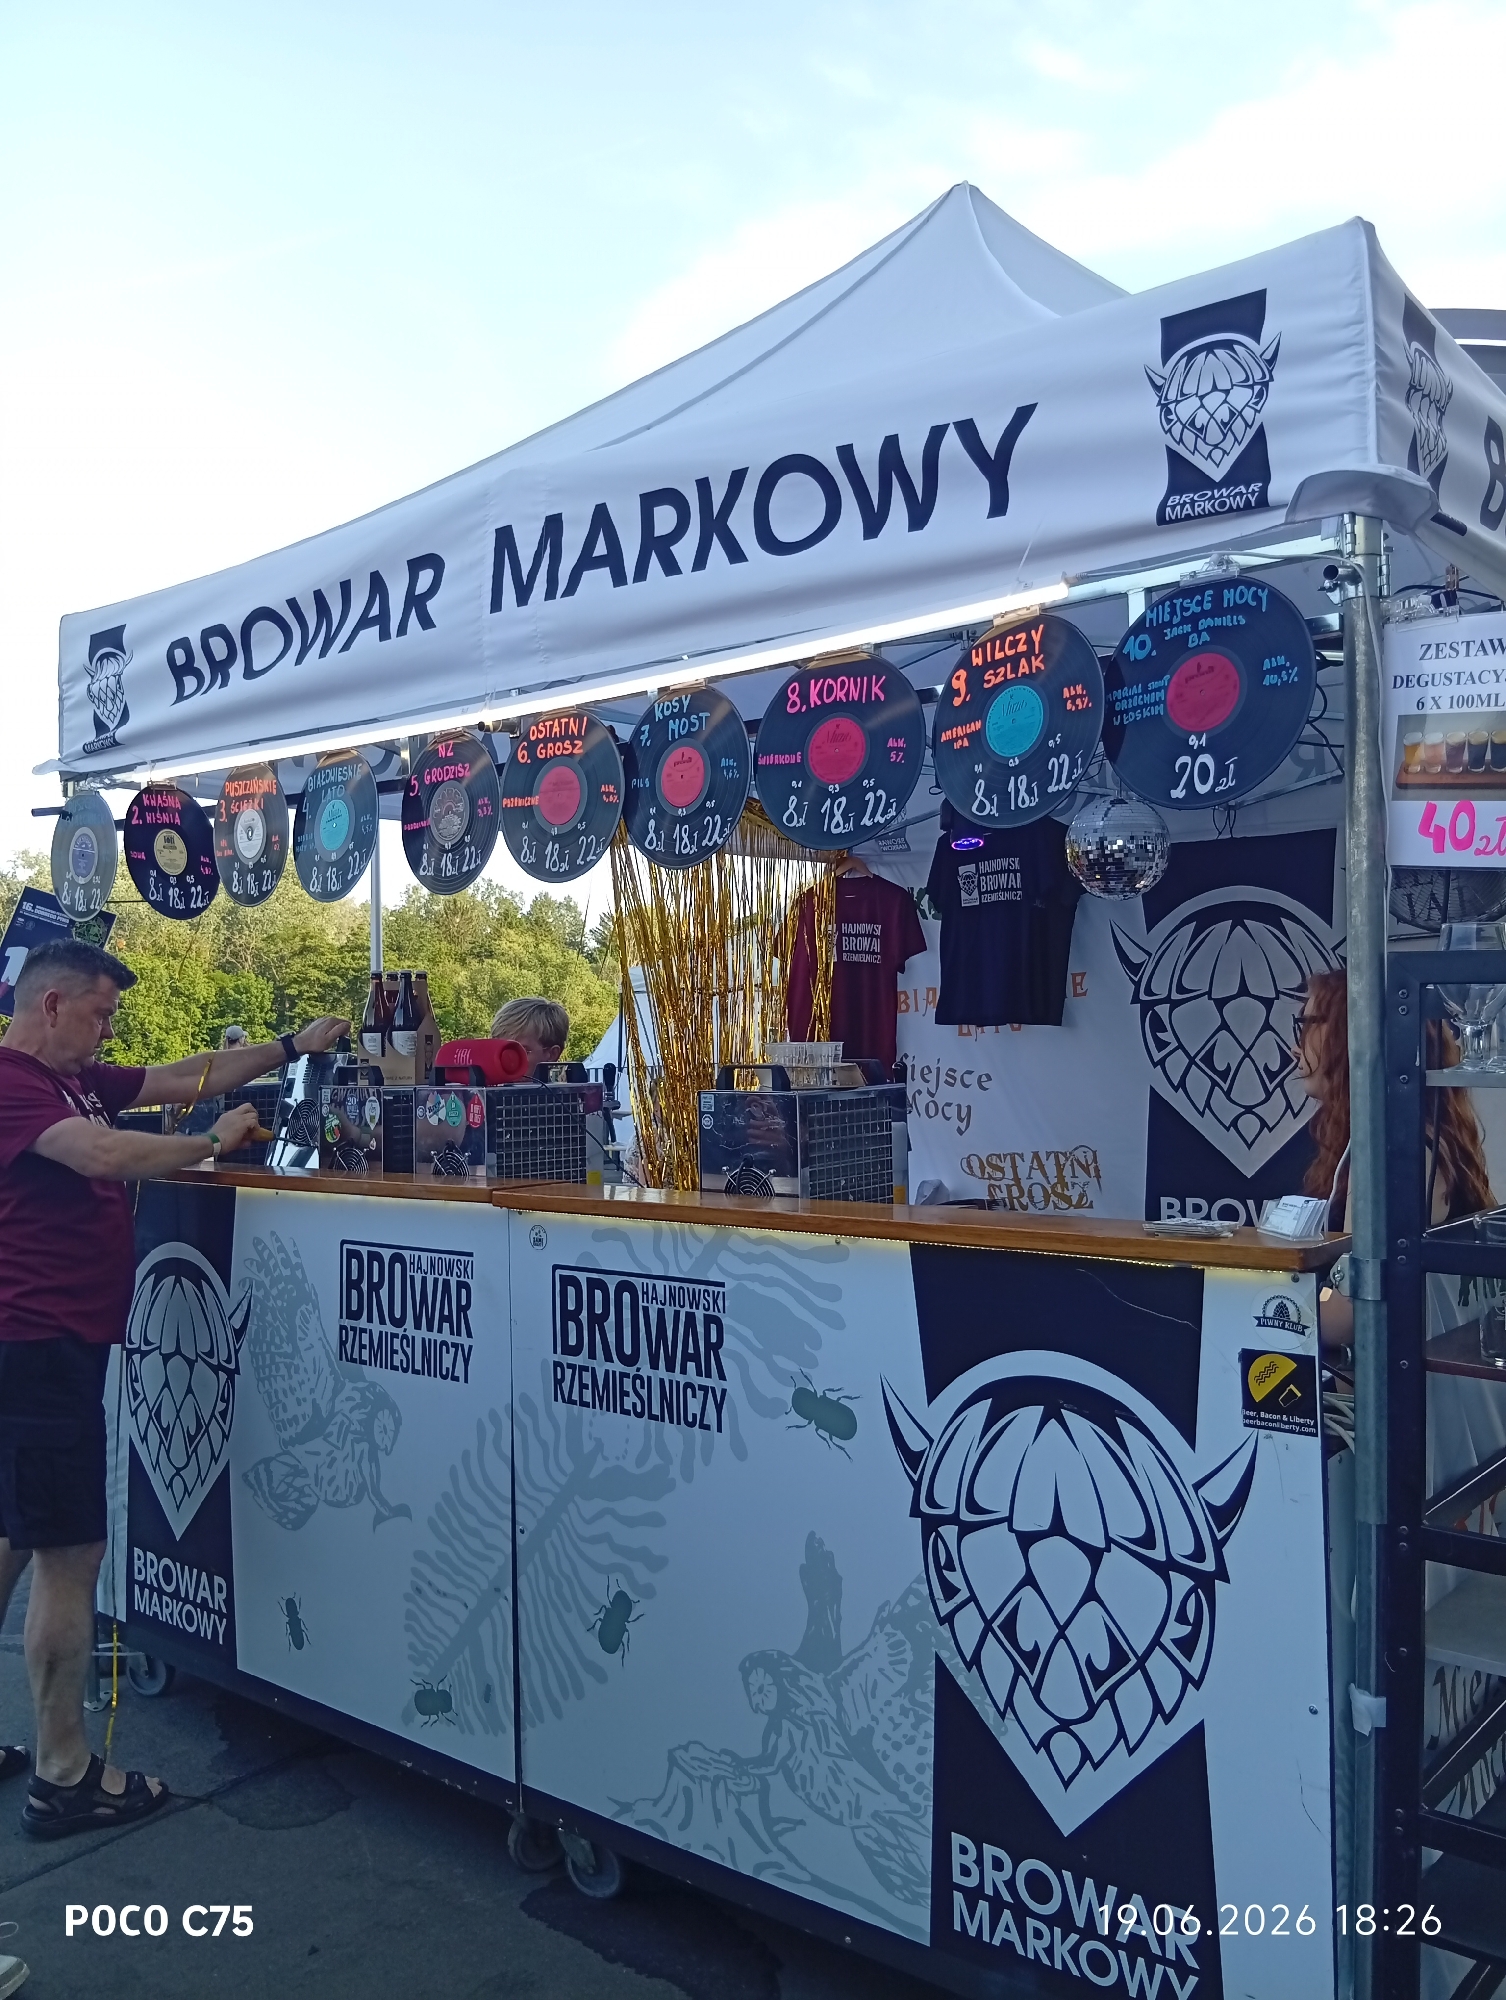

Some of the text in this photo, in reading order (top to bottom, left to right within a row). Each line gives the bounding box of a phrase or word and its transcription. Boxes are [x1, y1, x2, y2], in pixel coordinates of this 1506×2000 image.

[1166, 482, 1263, 506] BROWAR
[1165, 492, 1258, 521] MARKOWY
[166, 402, 1038, 707] BROWAR MARKOWY
[1145, 585, 1269, 628] MIEJSCE MOCY
[1163, 623, 1192, 641] JACK
[1188, 631, 1211, 648] BA
[971, 624, 1045, 667] WILCZY
[1122, 633, 1157, 662] 10.
[1418, 637, 1506, 662] ZESTAW
[983, 653, 1045, 689] SZLAK
[1391, 668, 1506, 690] DEGUSTACY
[809, 674, 886, 708] KORNIK
[951, 668, 971, 707] 9.
[1062, 683, 1087, 699] ALK.
[1106, 683, 1142, 702] MPERIAL
[654, 693, 692, 722] KOSY
[1415, 692, 1505, 711] 6 X 100ML
[529, 716, 588, 741] OSTATNI
[668, 711, 711, 741] MOST
[940, 719, 982, 743] AMERICAN
[437, 740, 454, 758] NZ
[517, 739, 584, 764] 6. GROSZ
[886, 737, 907, 749] ALK.
[953, 737, 970, 750] IPA
[1188, 733, 1206, 749] 0,1
[424, 763, 471, 785] GRODZISZ
[631, 778, 650, 790] PILS
[862, 778, 876, 789] 0,5
[225, 776, 277, 798] PUSZCZAŃSKIE
[321, 784, 346, 801] LATO
[142, 791, 182, 810] KWAŚNA
[219, 799, 228, 822] 3.
[230, 797, 264, 814] ŚCIEŻKI
[131, 805, 143, 825] 2.
[978, 857, 1020, 874] HAJNOWSK
[186, 874, 195, 884] 0,5
[841, 922, 882, 936] HAJNOWS
[842, 936, 880, 953] BROWA
[842, 952, 882, 964] RZEMIEŚLNICZ
[454, 1048, 473, 1066] JBL
[408, 1253, 474, 1280] HAJNOWSKI
[345, 1247, 474, 1339] BROWAR
[641, 1281, 727, 1314] HAJNOWSKI
[558, 1273, 727, 1381] BROWAR
[1260, 1317, 1304, 1333] PIWNY KLUB
[338, 1323, 474, 1385] RZEMIEŚLNICZY
[552, 1360, 727, 1434] RZEMIEŚLNICZY
[1260, 1411, 1281, 1420] Bacon
[1289, 1415, 1315, 1426] Liberty
[133, 1546, 227, 1614] BROWAR
[134, 1583, 227, 1645] MARKOWY
[951, 1831, 1200, 1970] BROWAR
[952, 1890, 1200, 2000] MARKOWY
